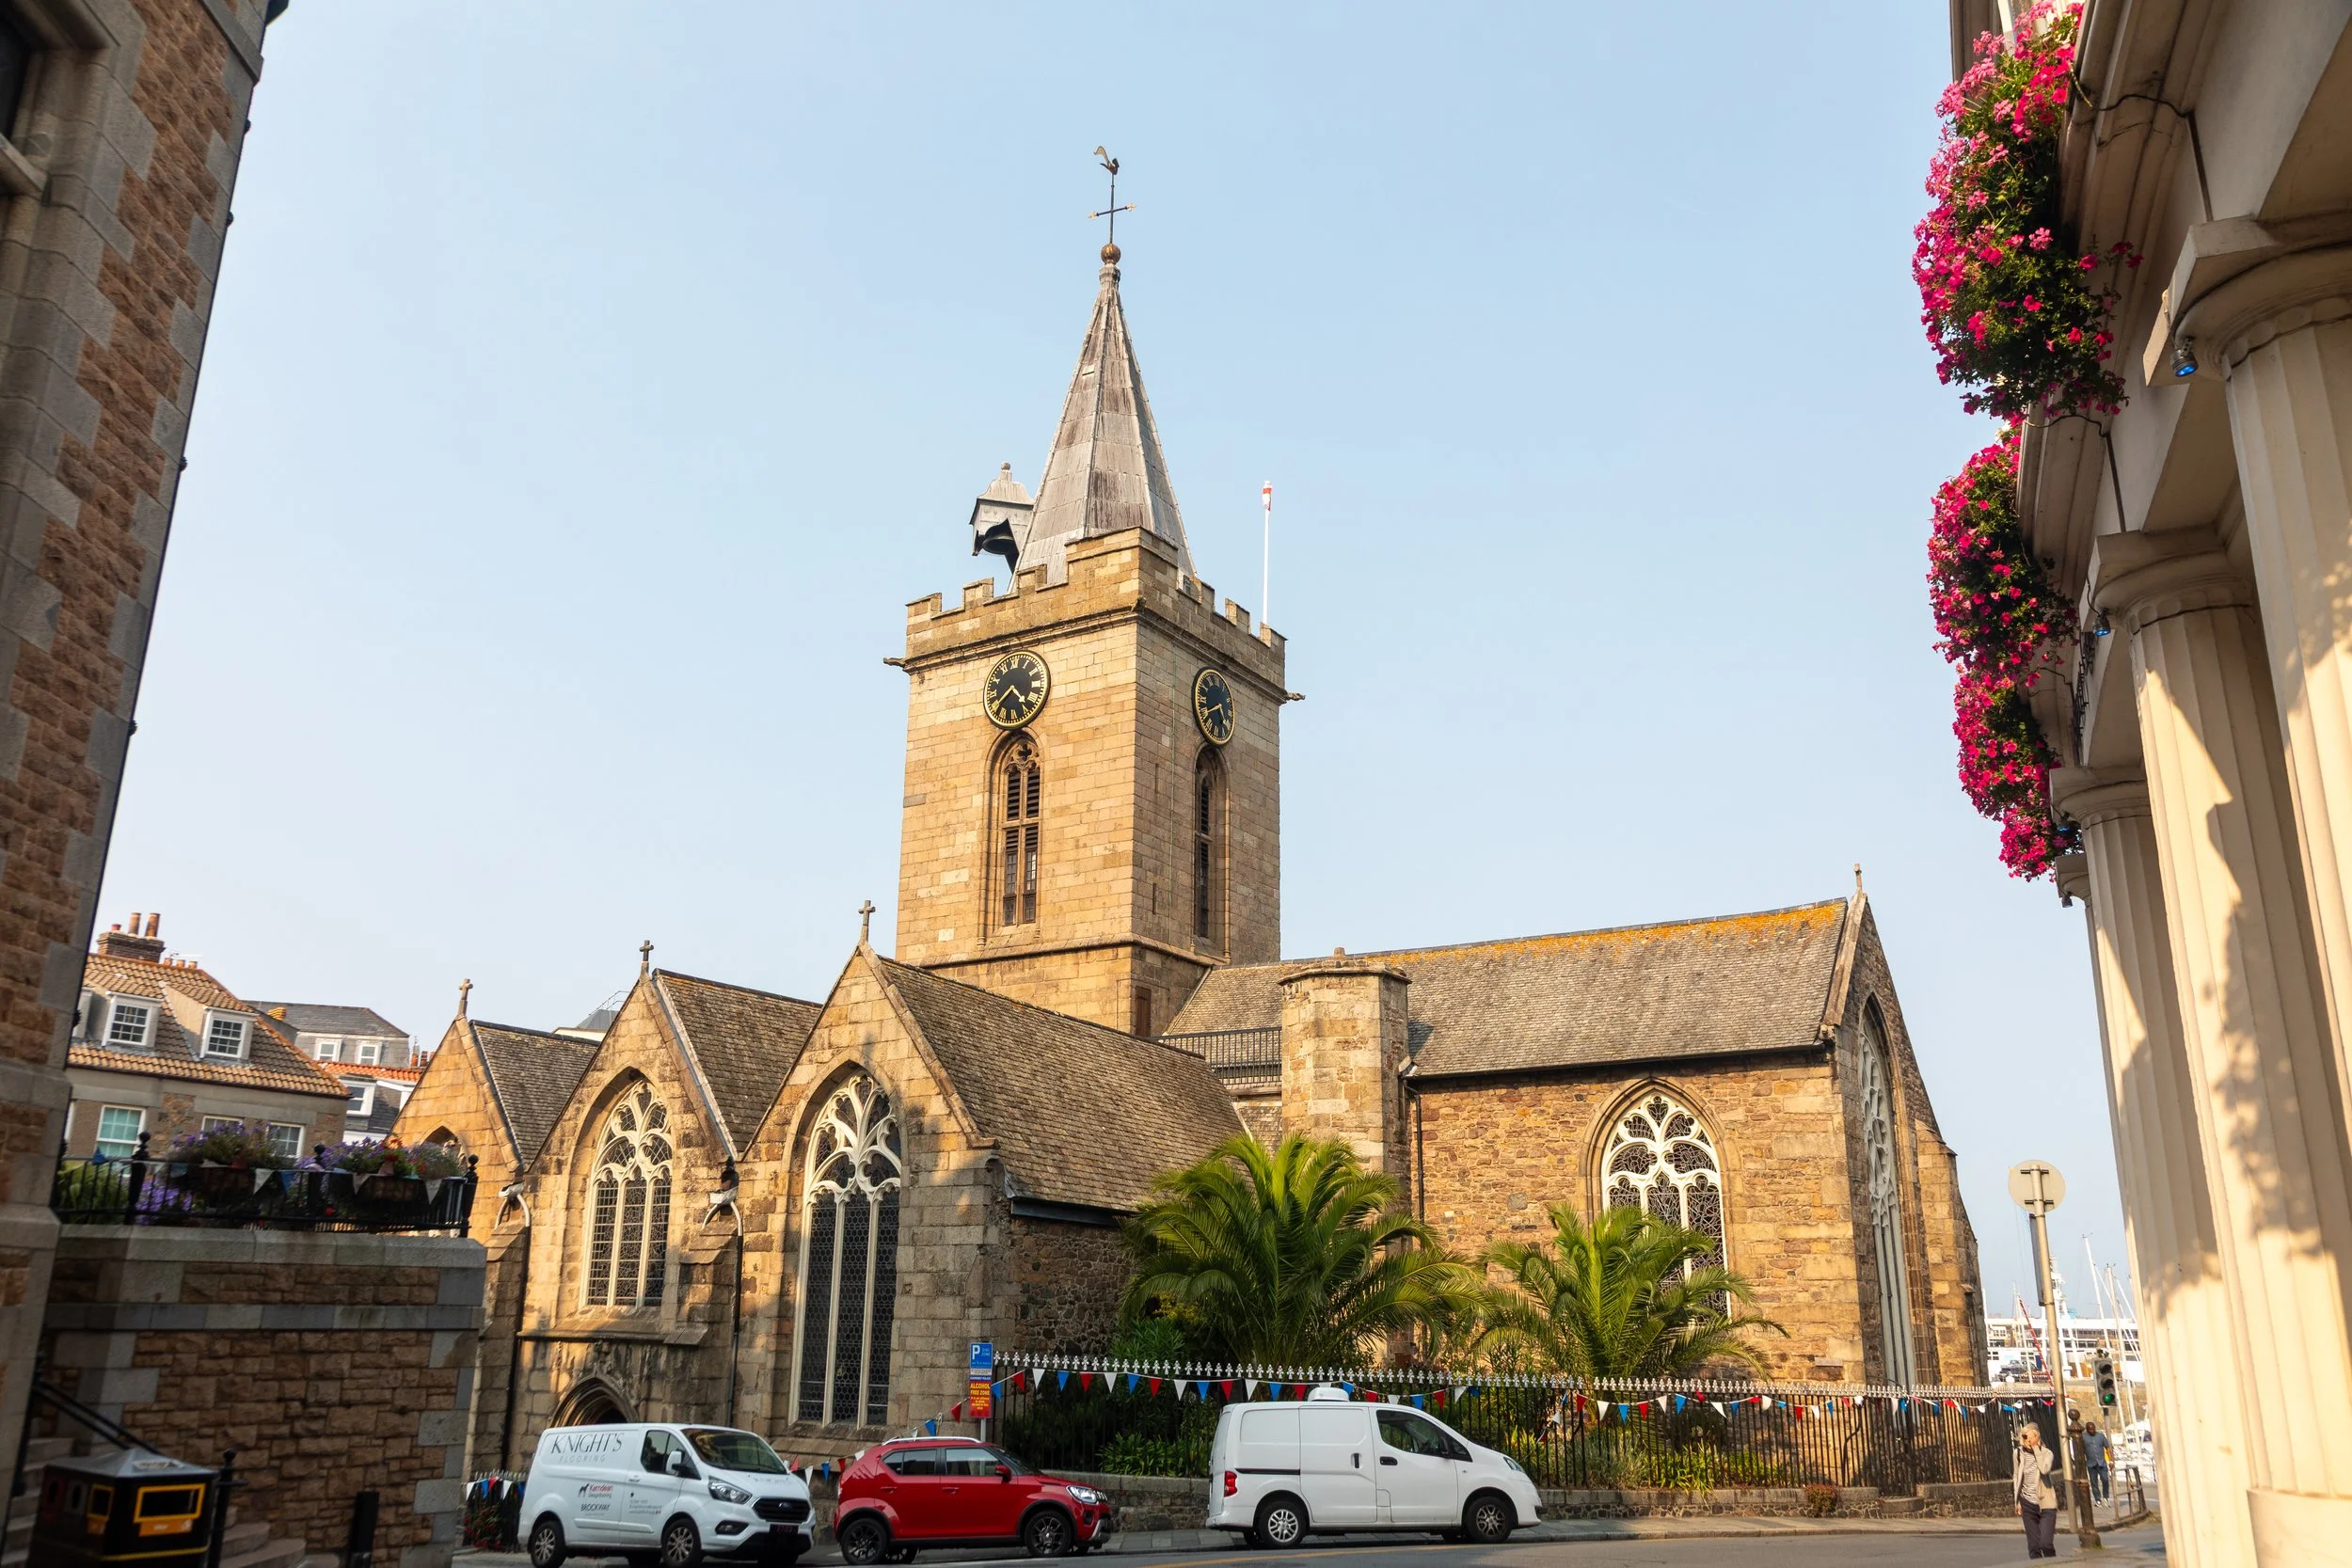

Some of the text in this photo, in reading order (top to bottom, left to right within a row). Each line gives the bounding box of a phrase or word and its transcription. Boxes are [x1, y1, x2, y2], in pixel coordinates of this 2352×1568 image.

[972, 1345, 980, 1360] P
[551, 1433, 625, 1453] KNIGHT'S
[559, 1455, 606, 1463] FLOORING
